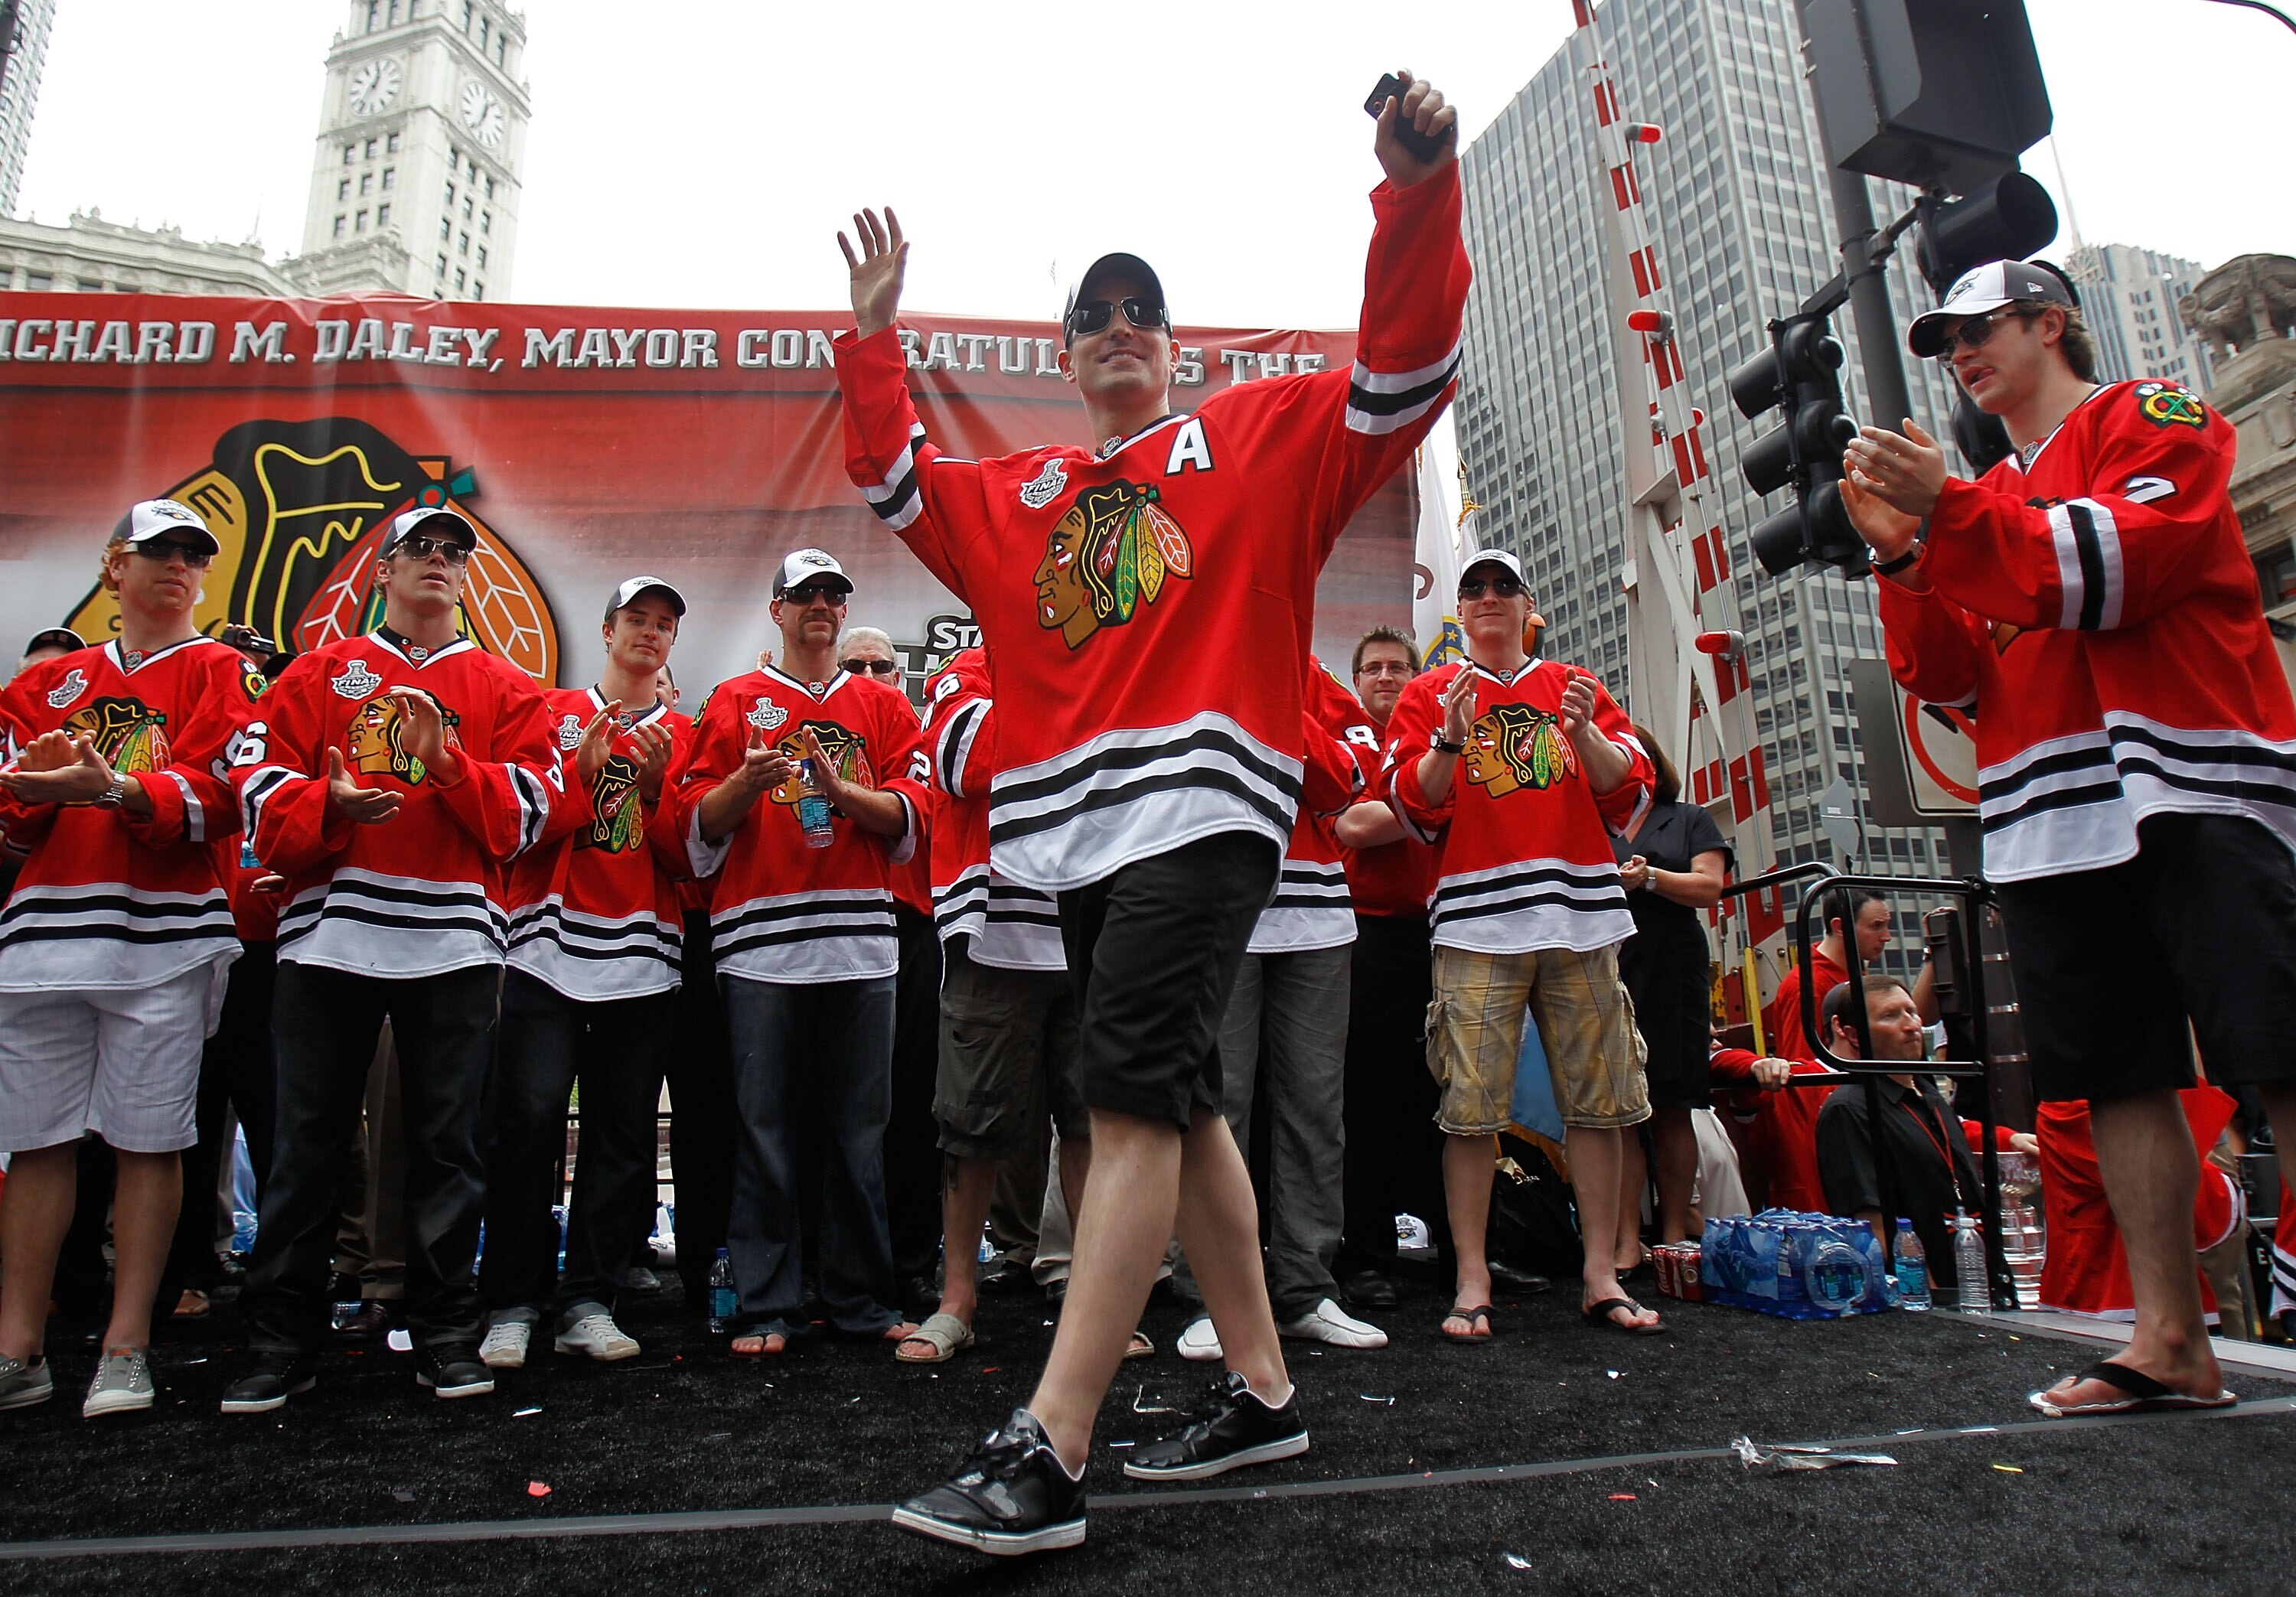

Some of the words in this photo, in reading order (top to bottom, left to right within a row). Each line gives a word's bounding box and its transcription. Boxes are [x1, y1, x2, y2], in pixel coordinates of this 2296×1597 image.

[229, 321, 296, 363] M.
[313, 318, 504, 373] DALEY,
[522, 328, 718, 368] MAYOR
[737, 329, 1205, 386] CONRATULS
[1165, 416, 1215, 476] A
[1026, 476, 1065, 494] FINAL
[338, 676, 378, 687] FINAL
[752, 709, 784, 720] FINAL
